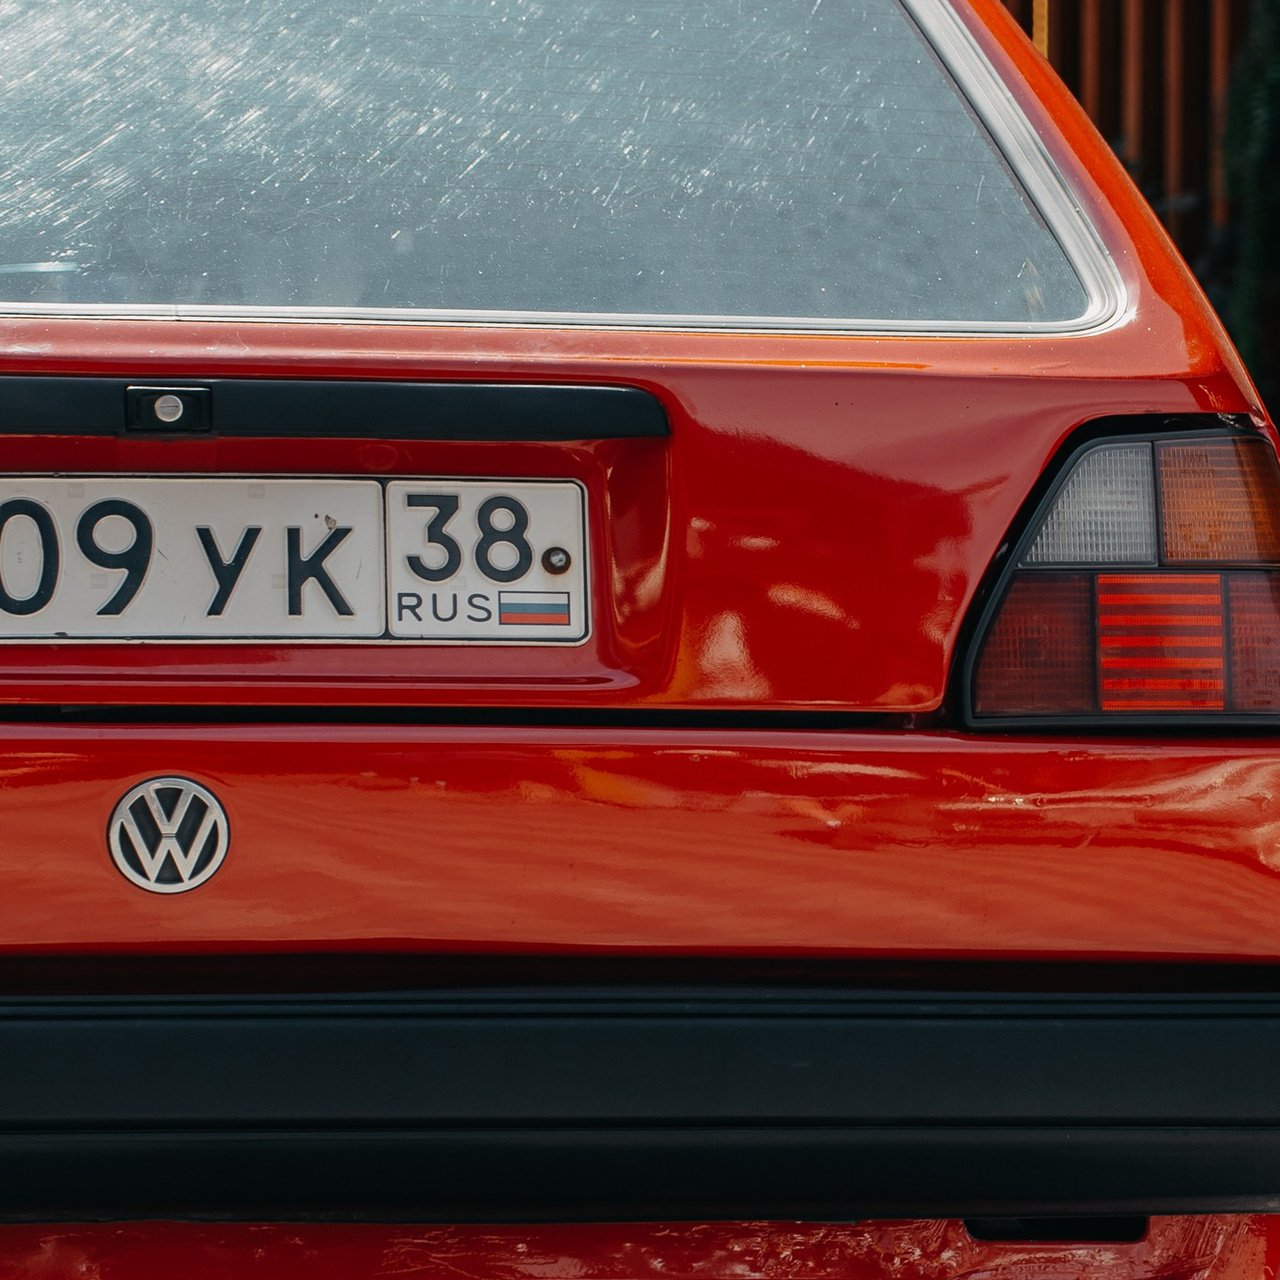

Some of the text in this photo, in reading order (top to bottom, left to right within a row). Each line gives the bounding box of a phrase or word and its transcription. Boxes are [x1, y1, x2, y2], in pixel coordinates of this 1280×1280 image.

[0, 499, 153, 616] 09
[405, 493, 533, 583] 38
[397, 592, 492, 622] RUS
[107, 775, 231, 894] VW
